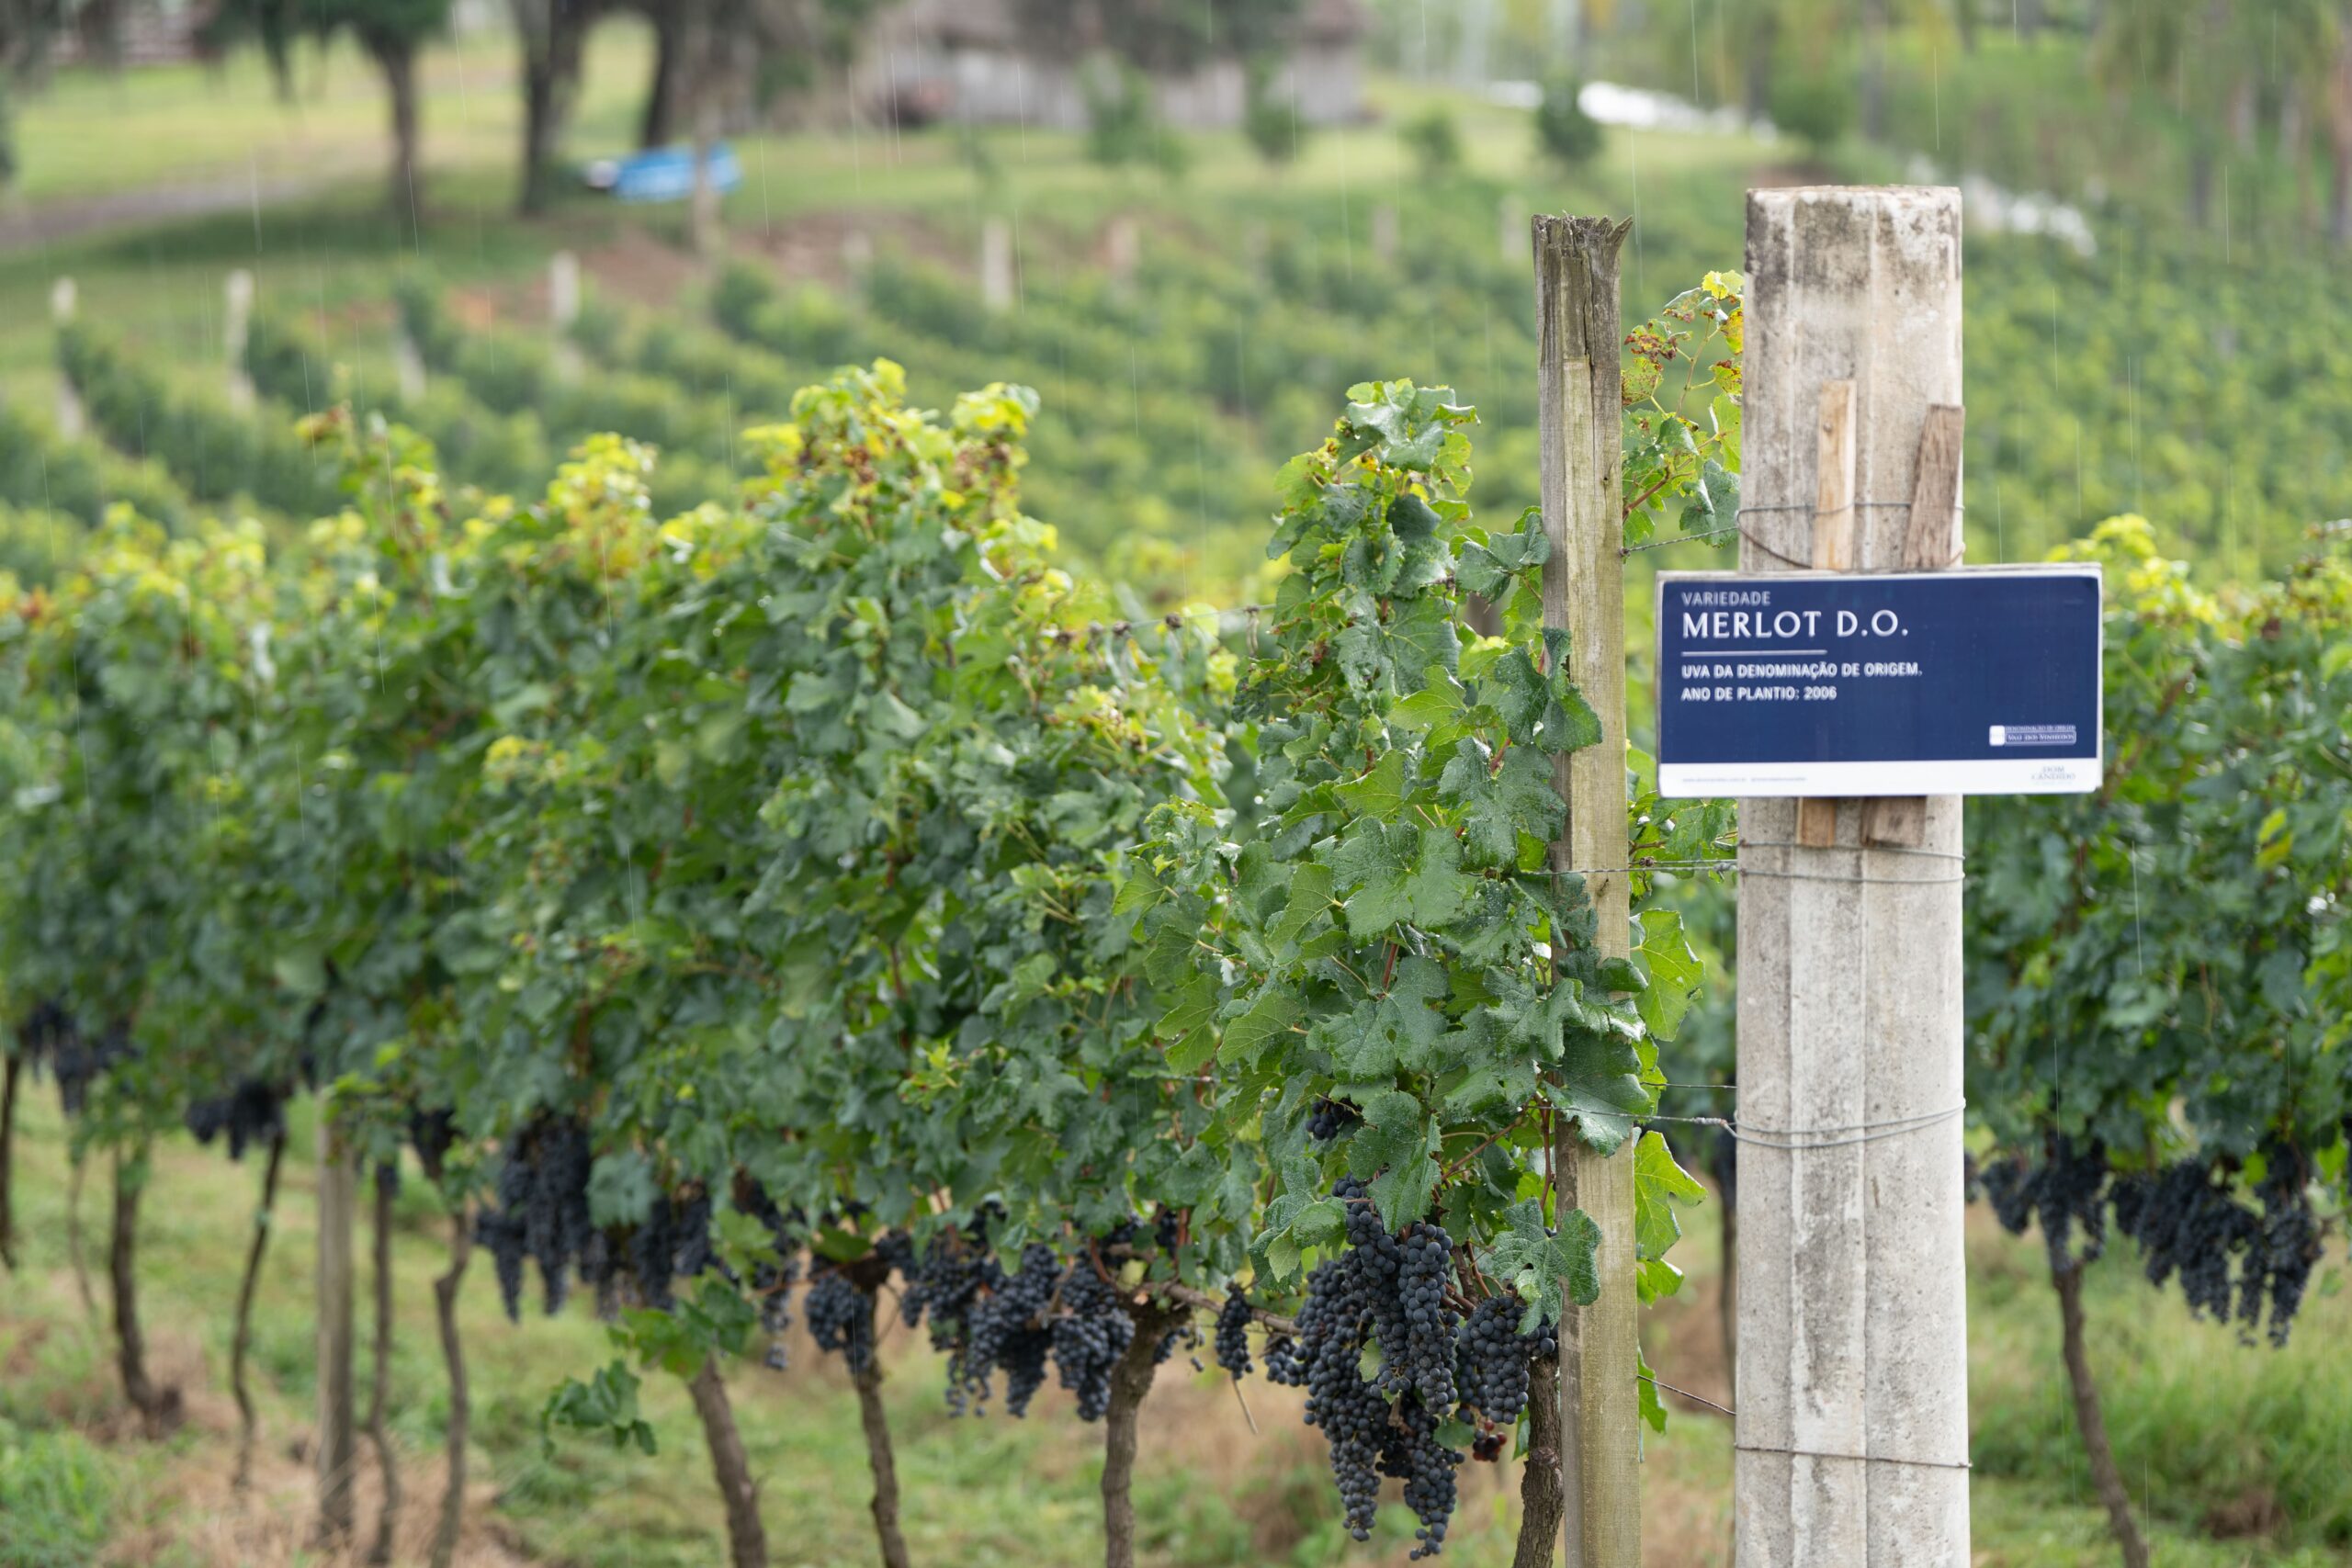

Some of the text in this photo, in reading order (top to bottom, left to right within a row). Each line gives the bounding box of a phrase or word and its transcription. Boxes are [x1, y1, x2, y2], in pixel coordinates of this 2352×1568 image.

[1680, 591, 1771, 606] VARIEDADE
[1682, 609, 1908, 638] MERLOT D.O.
[1681, 664, 1711, 679] UVA
[1713, 664, 1734, 679] DA
[1736, 661, 1838, 680] DENOMINAÇÃO
[1841, 662, 1860, 677] DE
[1680, 685, 1838, 701] ANO DE PLANTIO: 2006
